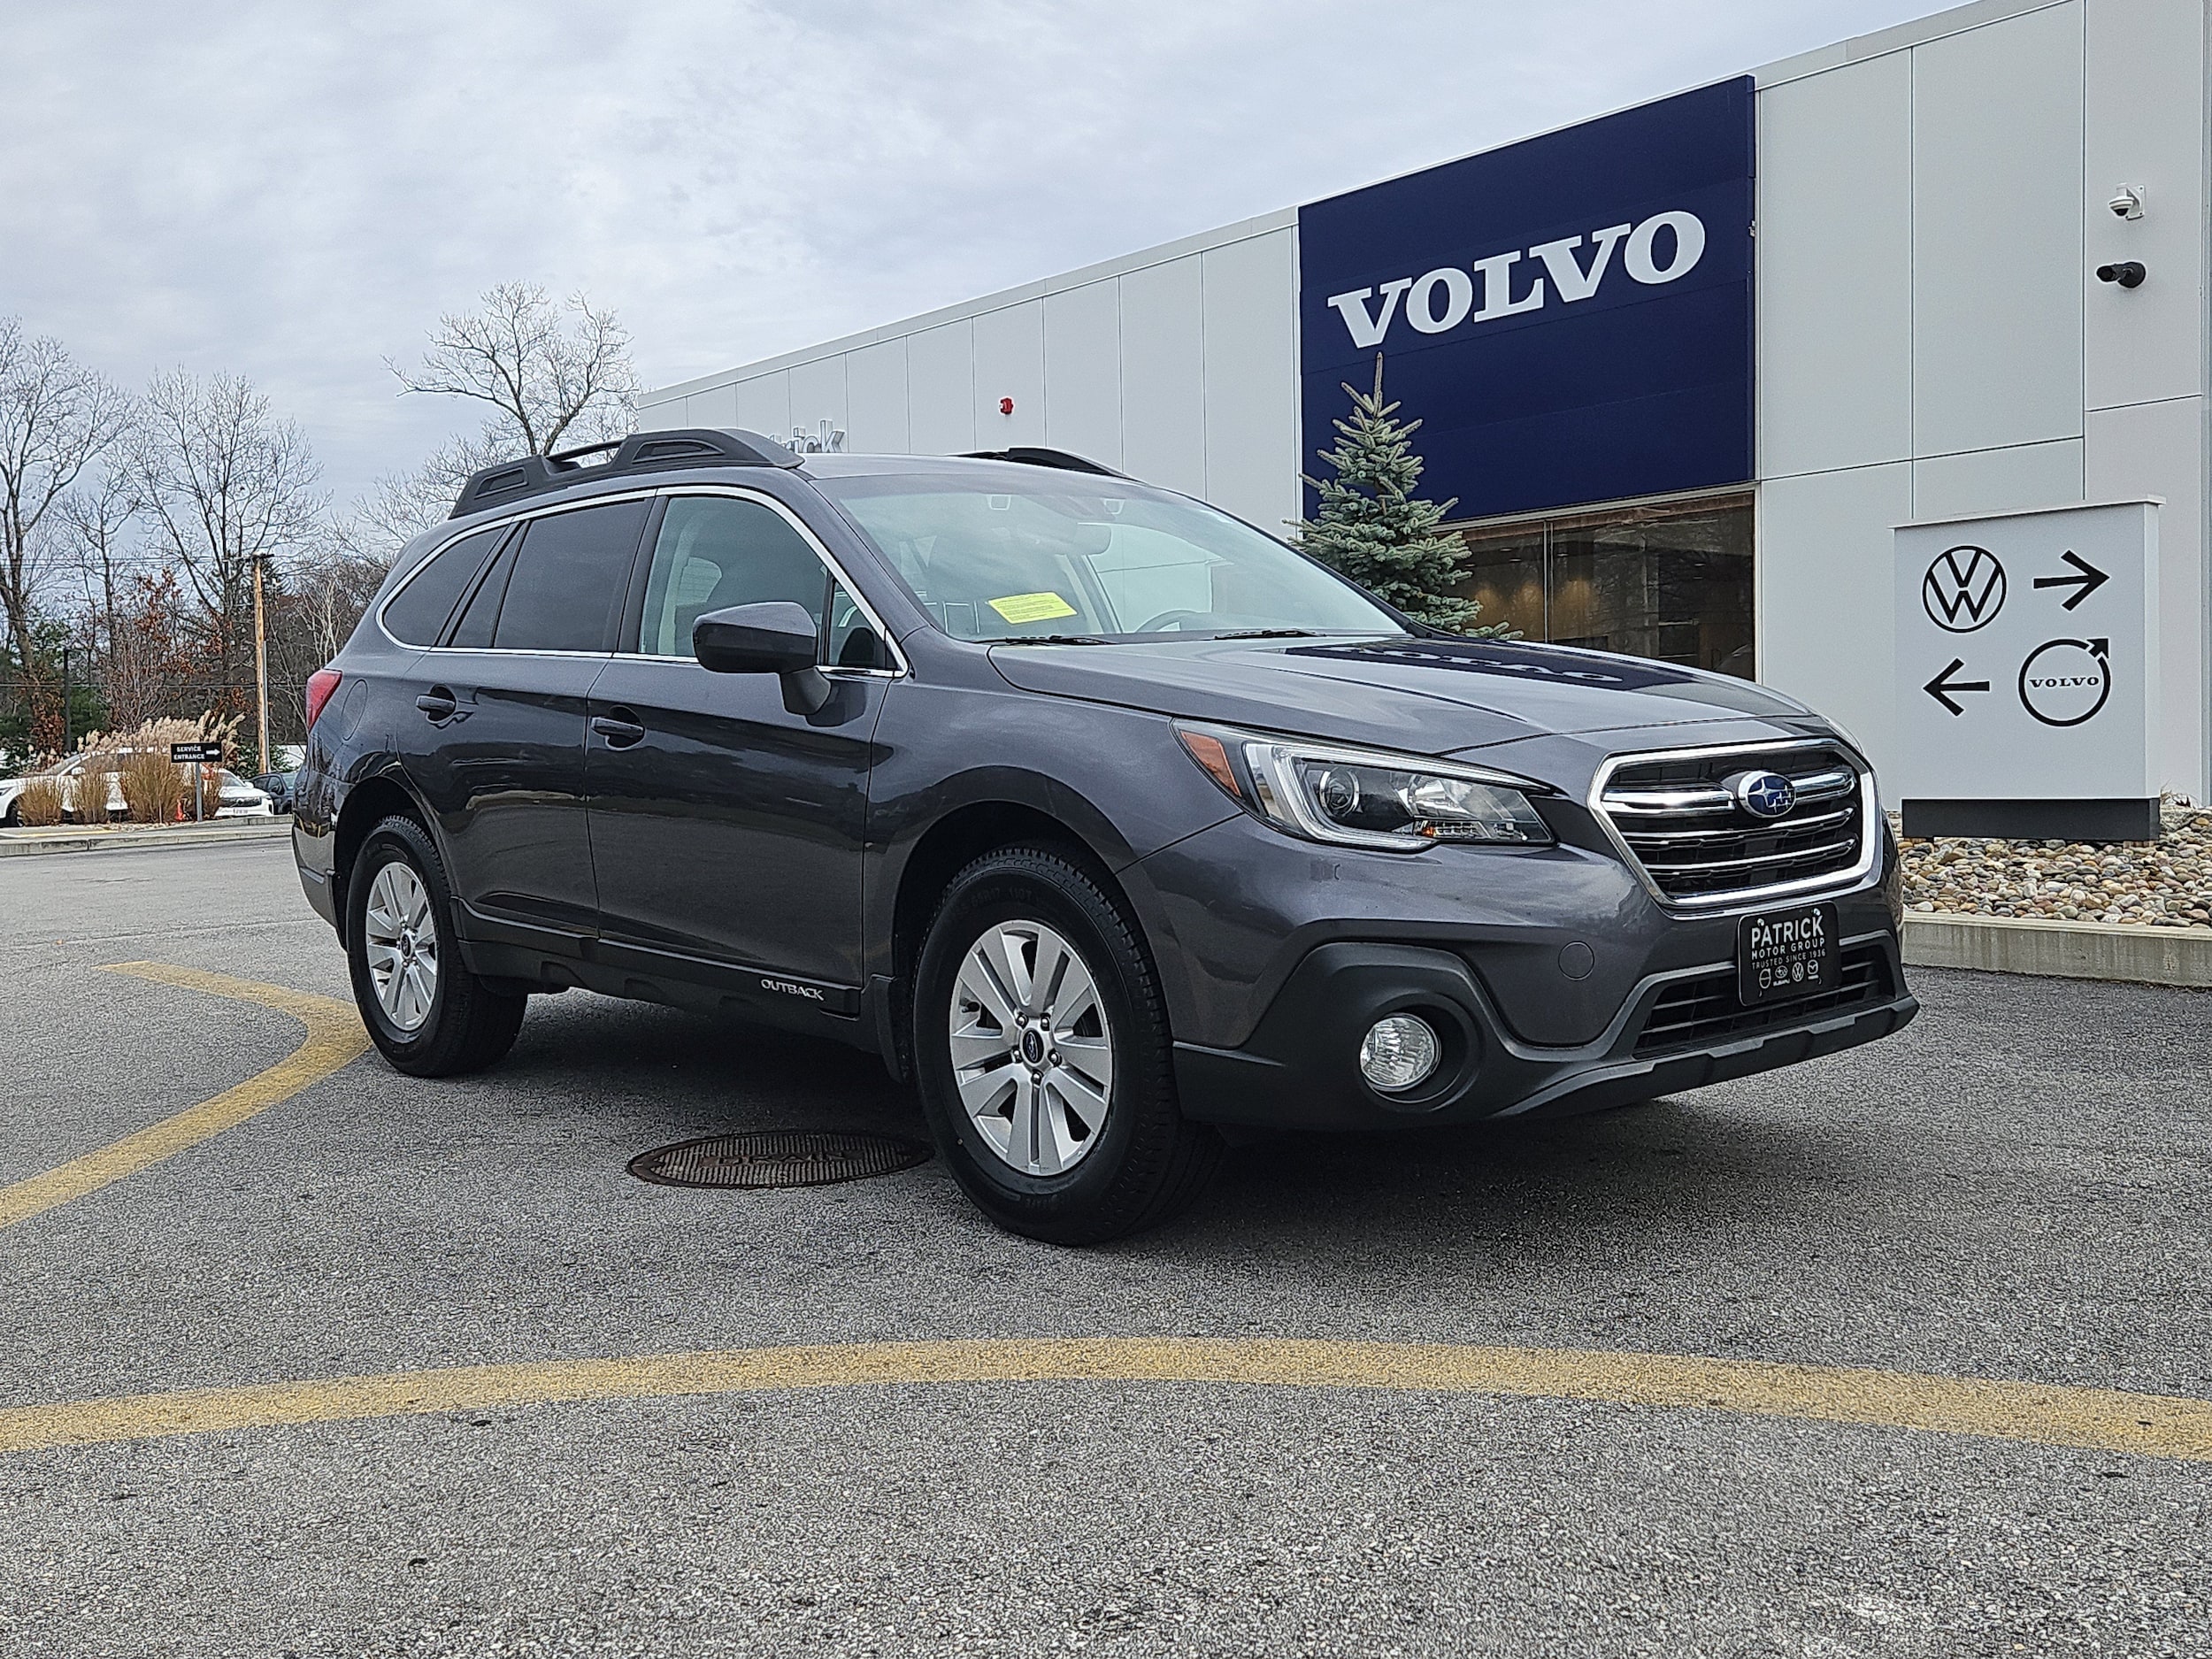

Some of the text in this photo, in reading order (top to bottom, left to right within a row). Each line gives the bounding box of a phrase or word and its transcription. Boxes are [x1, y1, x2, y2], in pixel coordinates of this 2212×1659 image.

[1328, 211, 1705, 349] VOLVO
[2028, 676, 2100, 688] VOLVO
[1751, 915, 1824, 949] PATRICK
[1751, 937, 1825, 961] MOTOR GROUP
[1751, 956, 1783, 971] TRUSTED
[1786, 952, 1807, 964] SINCE
[761, 979, 825, 1002] OUTBACK
